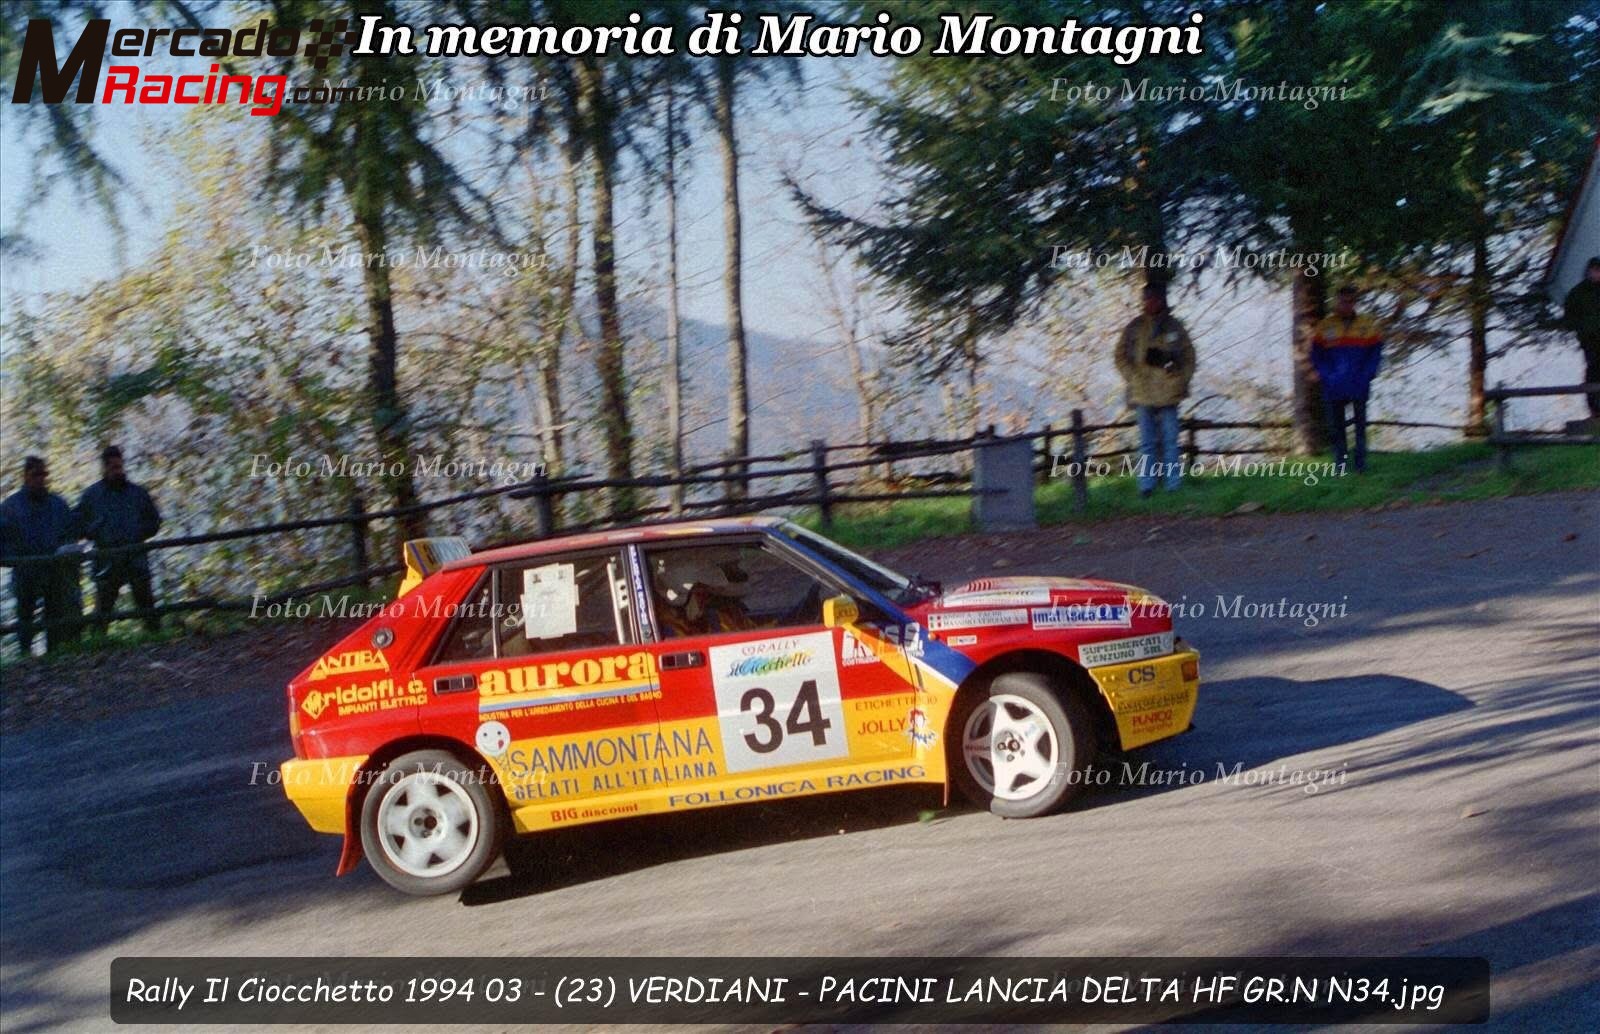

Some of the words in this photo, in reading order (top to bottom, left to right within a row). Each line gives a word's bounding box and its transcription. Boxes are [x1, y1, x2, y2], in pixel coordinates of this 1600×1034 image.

[1082, 637, 1161, 656] SUPERMERCATI
[479, 651, 660, 697] aurora
[1128, 665, 1156, 685] CS
[338, 702, 378, 716] IMPIANTI
[740, 679, 831, 754] 34
[858, 717, 906, 736] JOLLY
[511, 727, 714, 777] SAMMONTANA
[513, 778, 581, 800] GELATI
[592, 761, 717, 791] ALL'ITALIANA
[669, 780, 817, 808] FOLLONICA
[826, 765, 926, 788] RACING
[549, 807, 578, 823] BIG
[581, 803, 640, 819] discount
